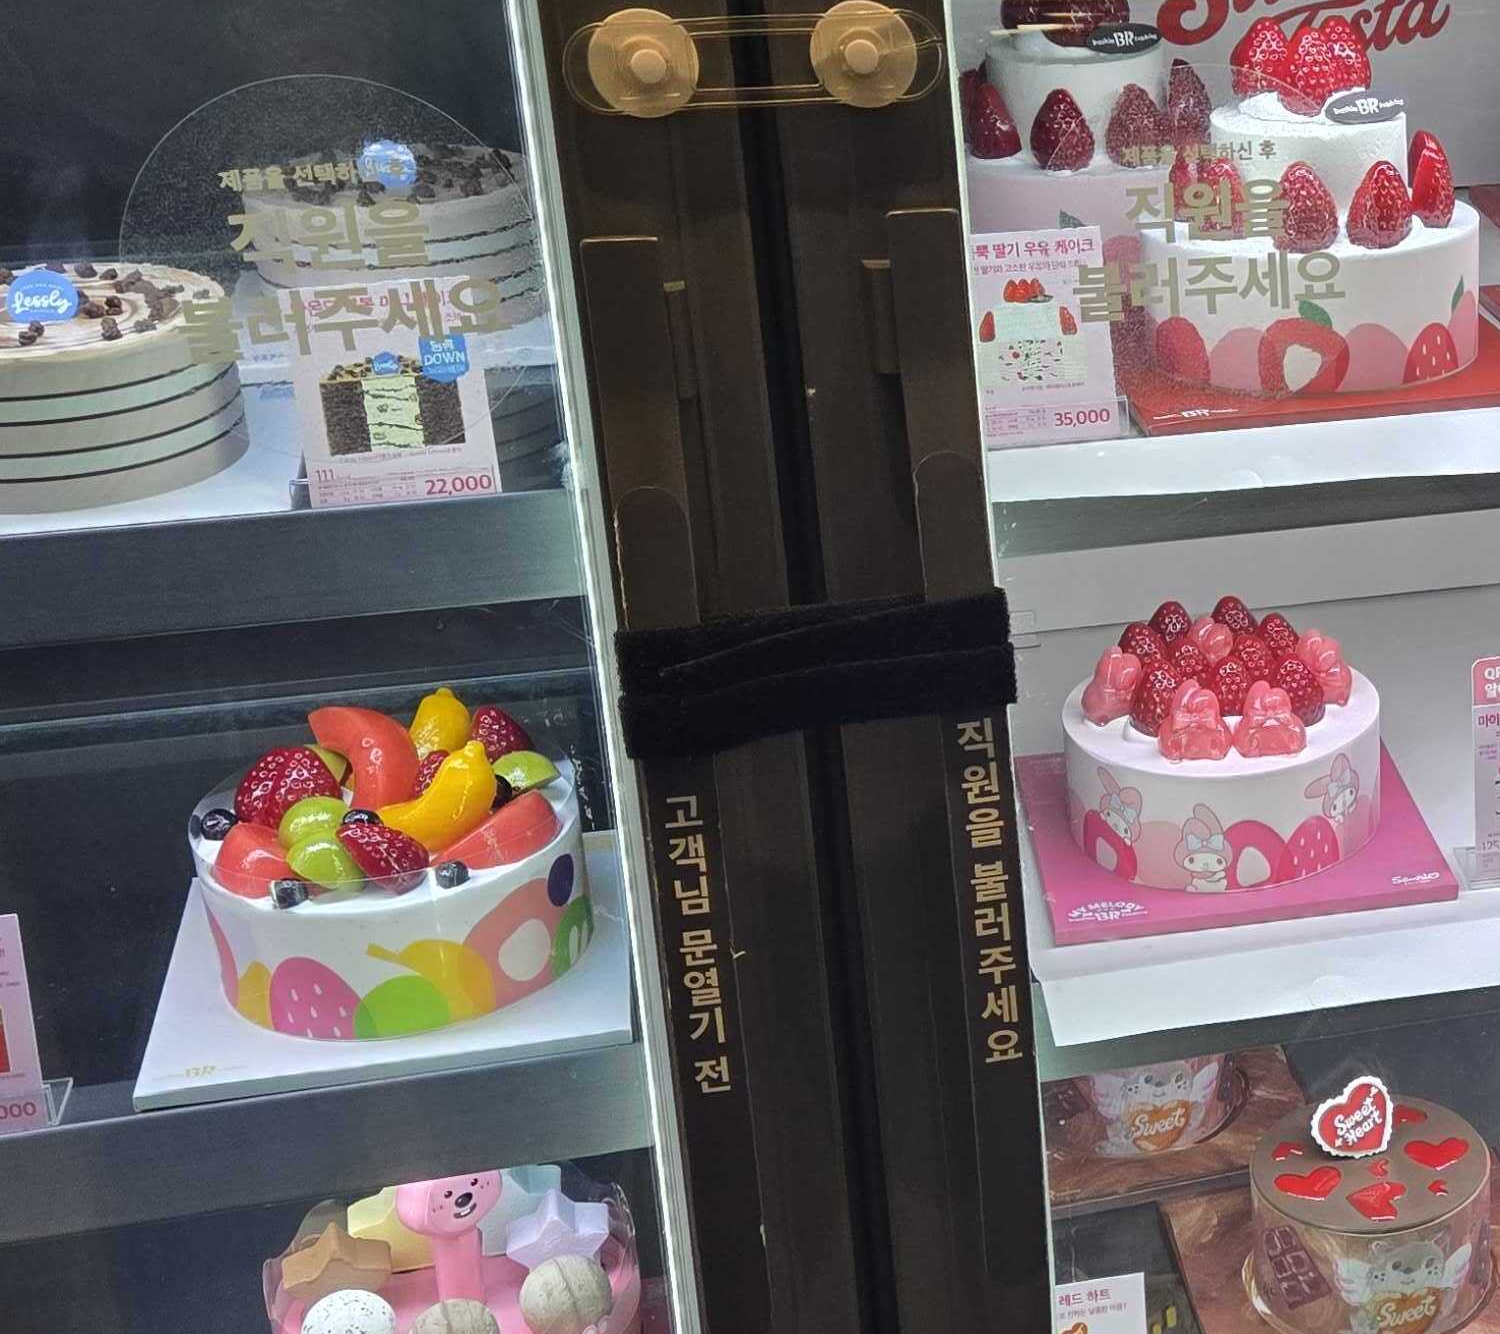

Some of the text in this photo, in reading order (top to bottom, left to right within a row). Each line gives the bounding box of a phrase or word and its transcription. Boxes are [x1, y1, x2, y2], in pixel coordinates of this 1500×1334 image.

[1113, 30, 1135, 47] BR
[1356, 98, 1379, 114] BR
[1120, 140, 1277, 166] 제품을 선택하신 후
[1125, 178, 1288, 244] 직원을
[227, 198, 430, 268] 직원을
[992, 238, 1095, 258] 딸기 우유 케이크
[12, 289, 72, 314] Lessly
[1073, 250, 1347, 323] 불러주세요
[177, 276, 514, 367] 불러주세요
[424, 350, 466, 366] DOWN
[1054, 409, 1111, 427] 35,000
[425, 474, 492, 495] 22,000
[957, 717, 1023, 1064] 직원을 불러주세요
[665, 795, 731, 1094] 고객님 문열기 전
[1133, 1107, 1187, 1137] Sweet
[1333, 1098, 1376, 1135] Sweet
[1343, 1111, 1382, 1147] Heart
[1059, 1288, 1112, 1307] 레드 하트
[1377, 1296, 1436, 1329] Sweet
